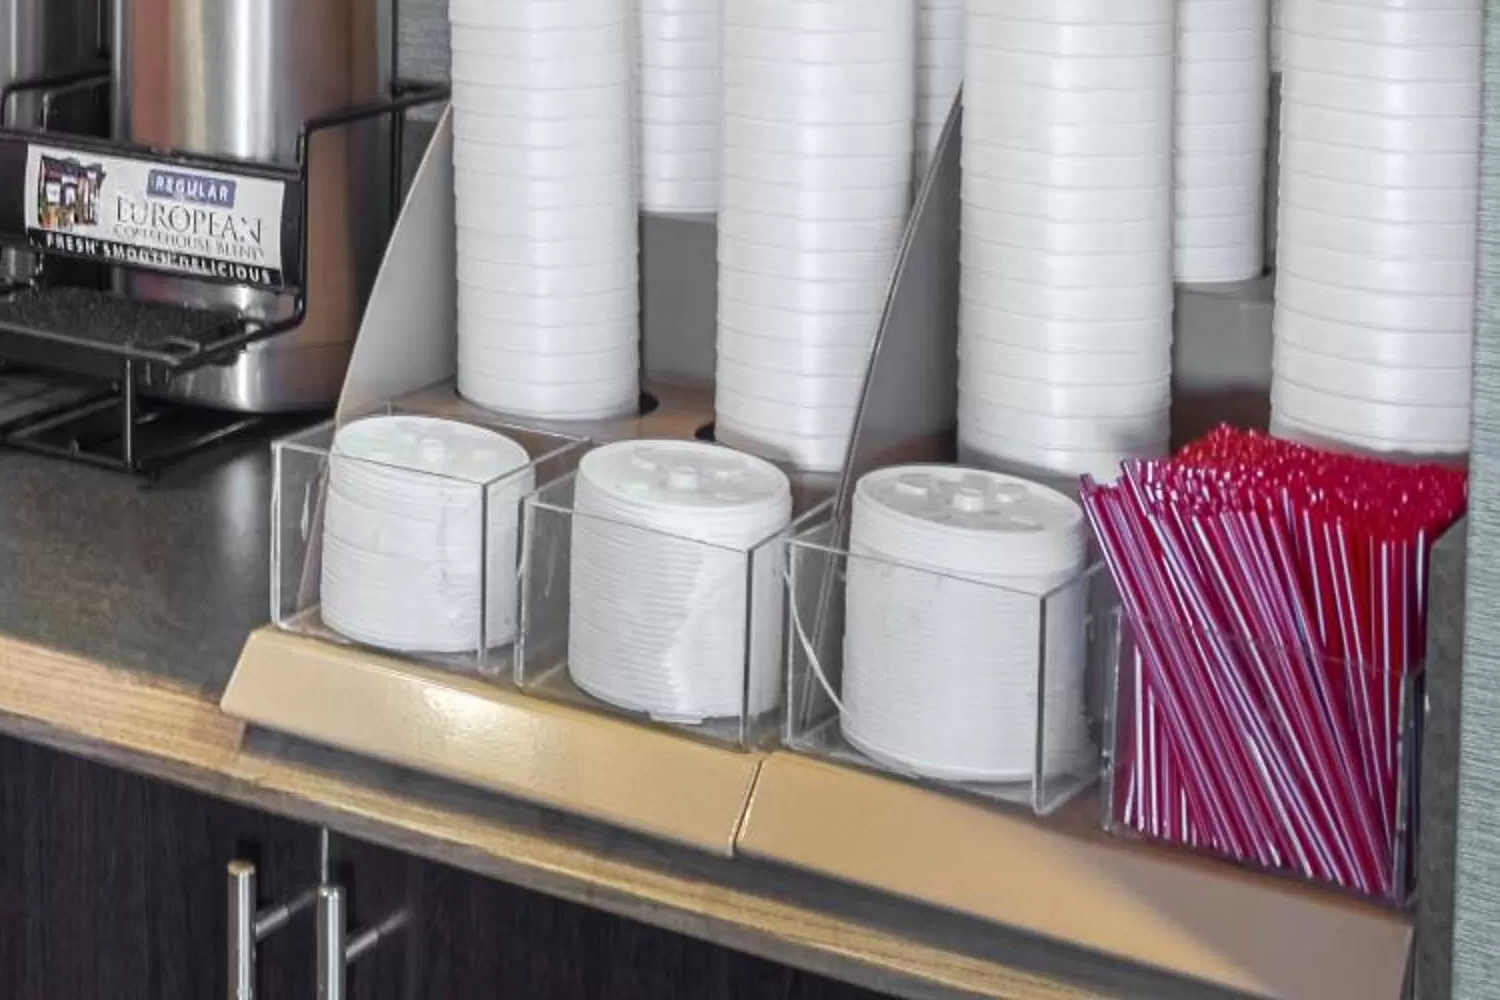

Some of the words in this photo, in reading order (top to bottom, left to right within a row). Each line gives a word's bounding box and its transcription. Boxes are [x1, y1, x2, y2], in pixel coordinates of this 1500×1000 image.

[155, 174, 230, 203] REGULAR
[115, 194, 263, 246] EUROPEAN
[46, 233, 97, 255] FRESH
